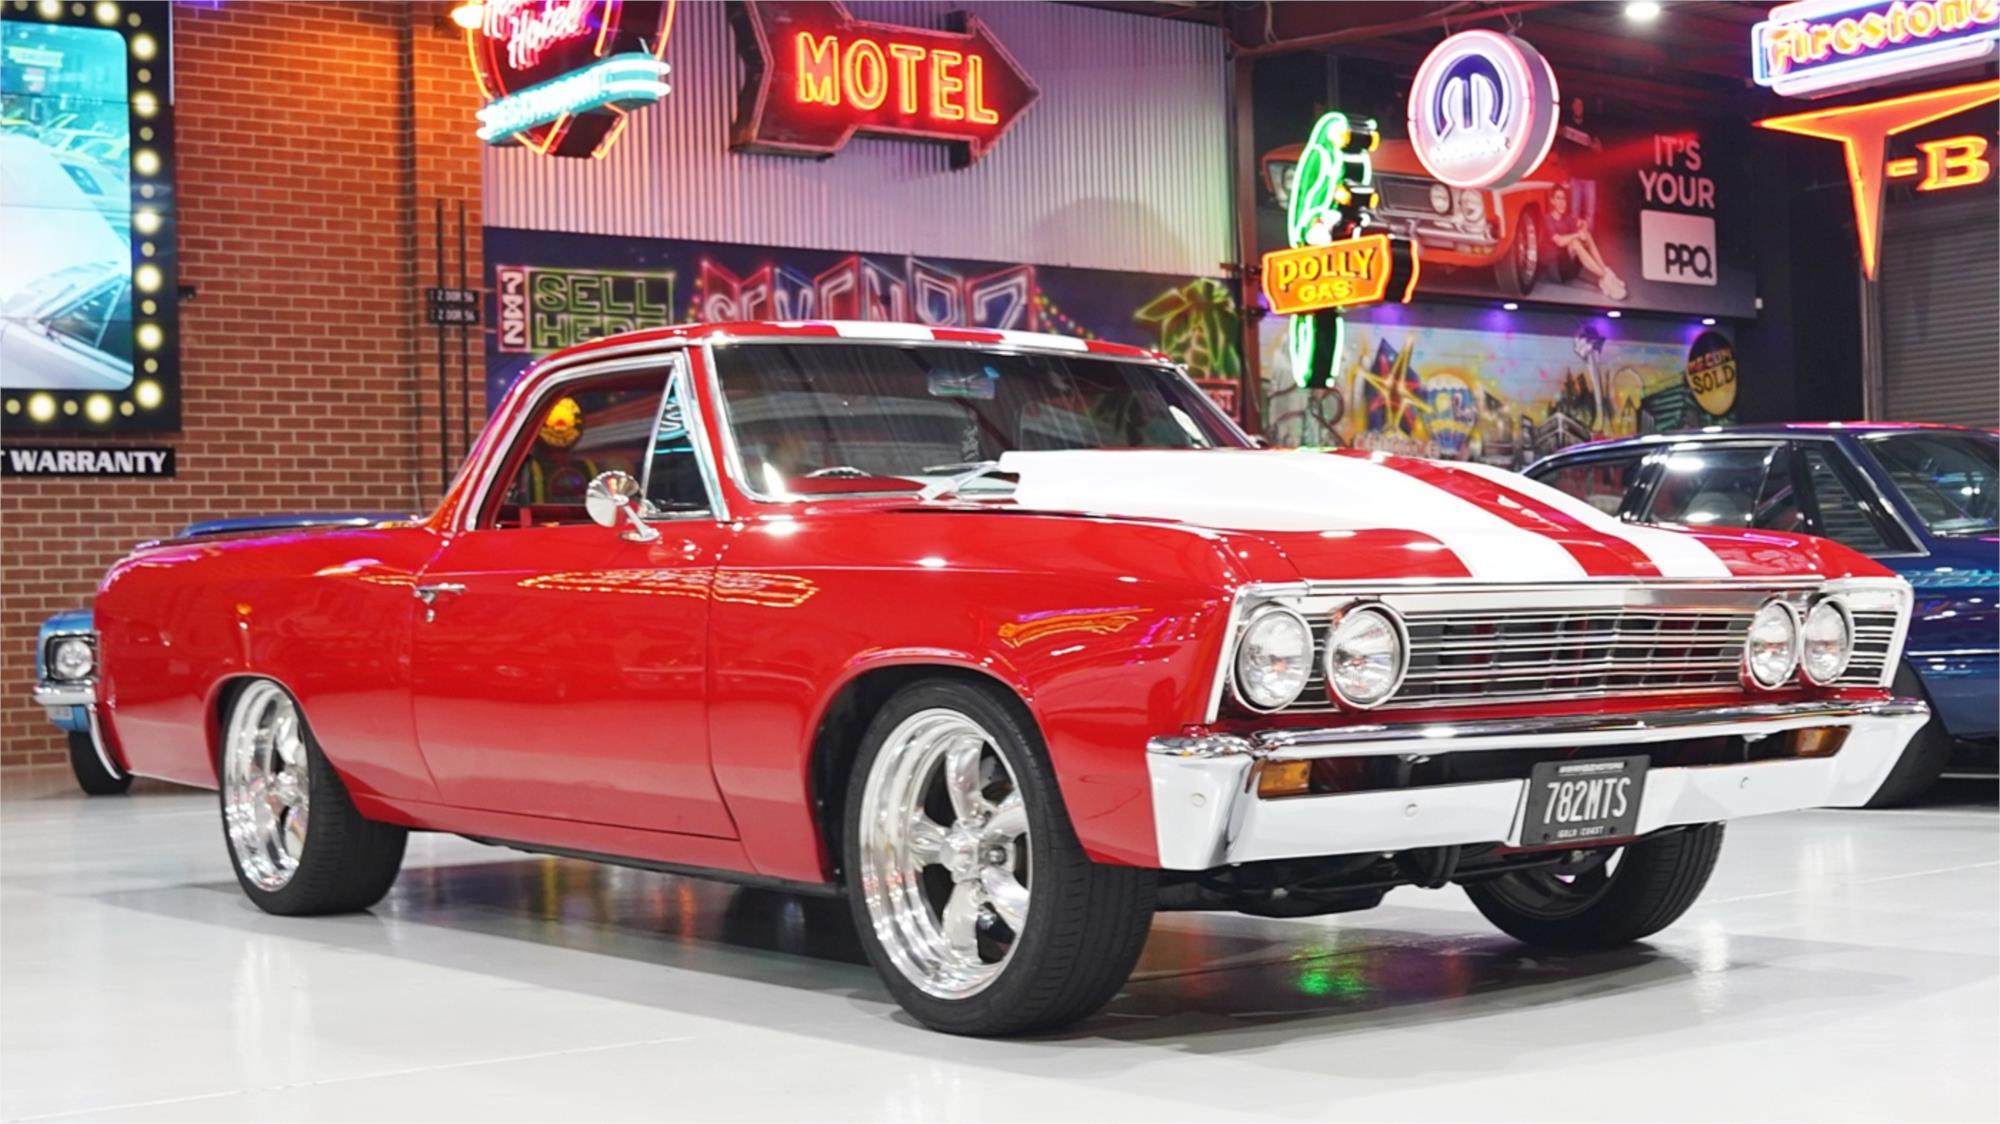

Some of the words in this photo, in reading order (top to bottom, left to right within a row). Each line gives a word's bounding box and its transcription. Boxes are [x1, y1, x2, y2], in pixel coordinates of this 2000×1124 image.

[1763, 0, 1999, 75] Firestone
[797, 32, 999, 124] MOTEL
[1654, 135, 1701, 171] IT'S
[1638, 169, 1715, 209] YOUR
[1276, 247, 1376, 291] POLLY
[1664, 242, 1712, 279] PPQ
[534, 273, 667, 316] SELL
[1298, 279, 1351, 302] GAS
[1692, 364, 1735, 395] SOLD
[9, 450, 167, 473] WARRANTY
[1543, 776, 1632, 825] 782MTS
